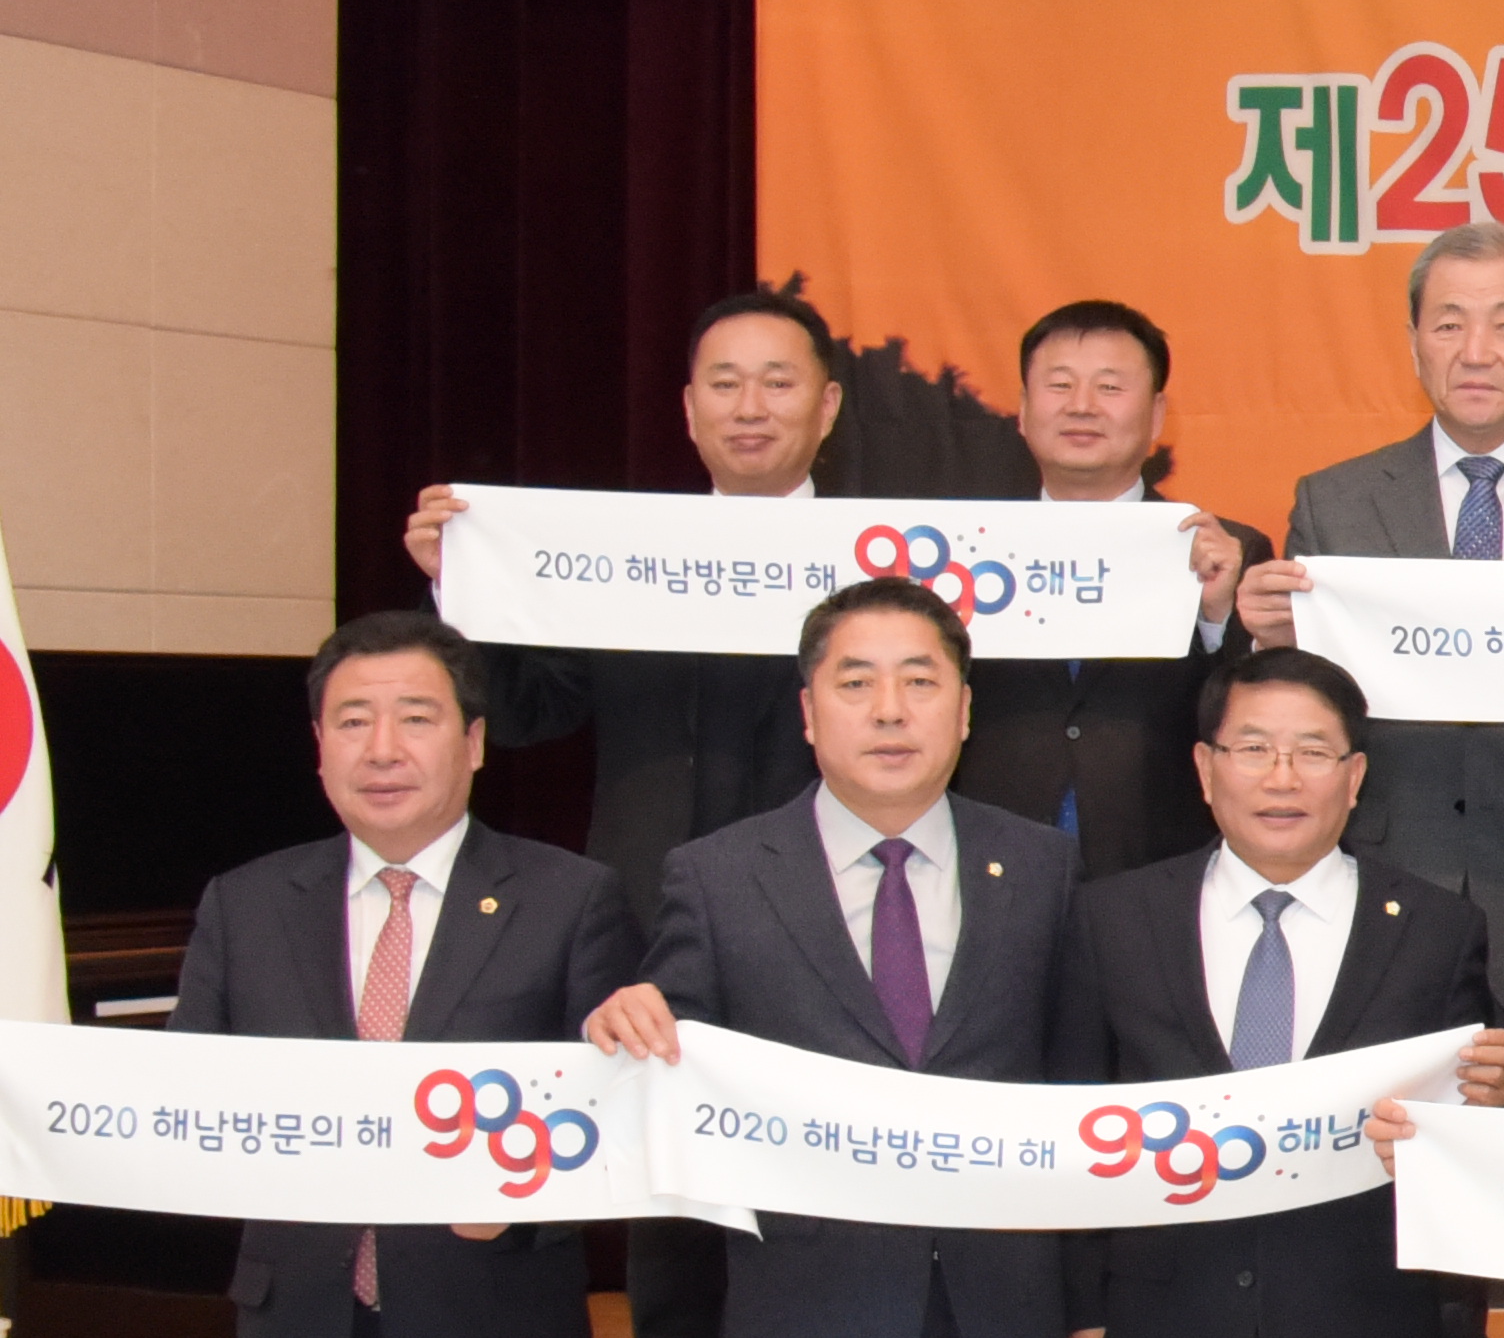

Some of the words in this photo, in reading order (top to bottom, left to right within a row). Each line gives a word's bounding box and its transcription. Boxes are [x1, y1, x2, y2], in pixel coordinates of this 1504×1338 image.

[535, 550, 613, 584] 2020
[626, 555, 794, 598] 해남방문의
[804, 562, 836, 592] 해
[1025, 558, 1110, 604] 해남
[1392, 626, 1472, 657] 2020
[47, 1101, 137, 1140] 2020
[152, 1106, 343, 1155] 해남방문의
[356, 1113, 392, 1149] 해
[694, 1104, 789, 1147] 2020
[803, 1117, 1004, 1173] 해남방문의
[1018, 1138, 1056, 1171] 해
[1277, 1108, 1370, 1153] 해남
